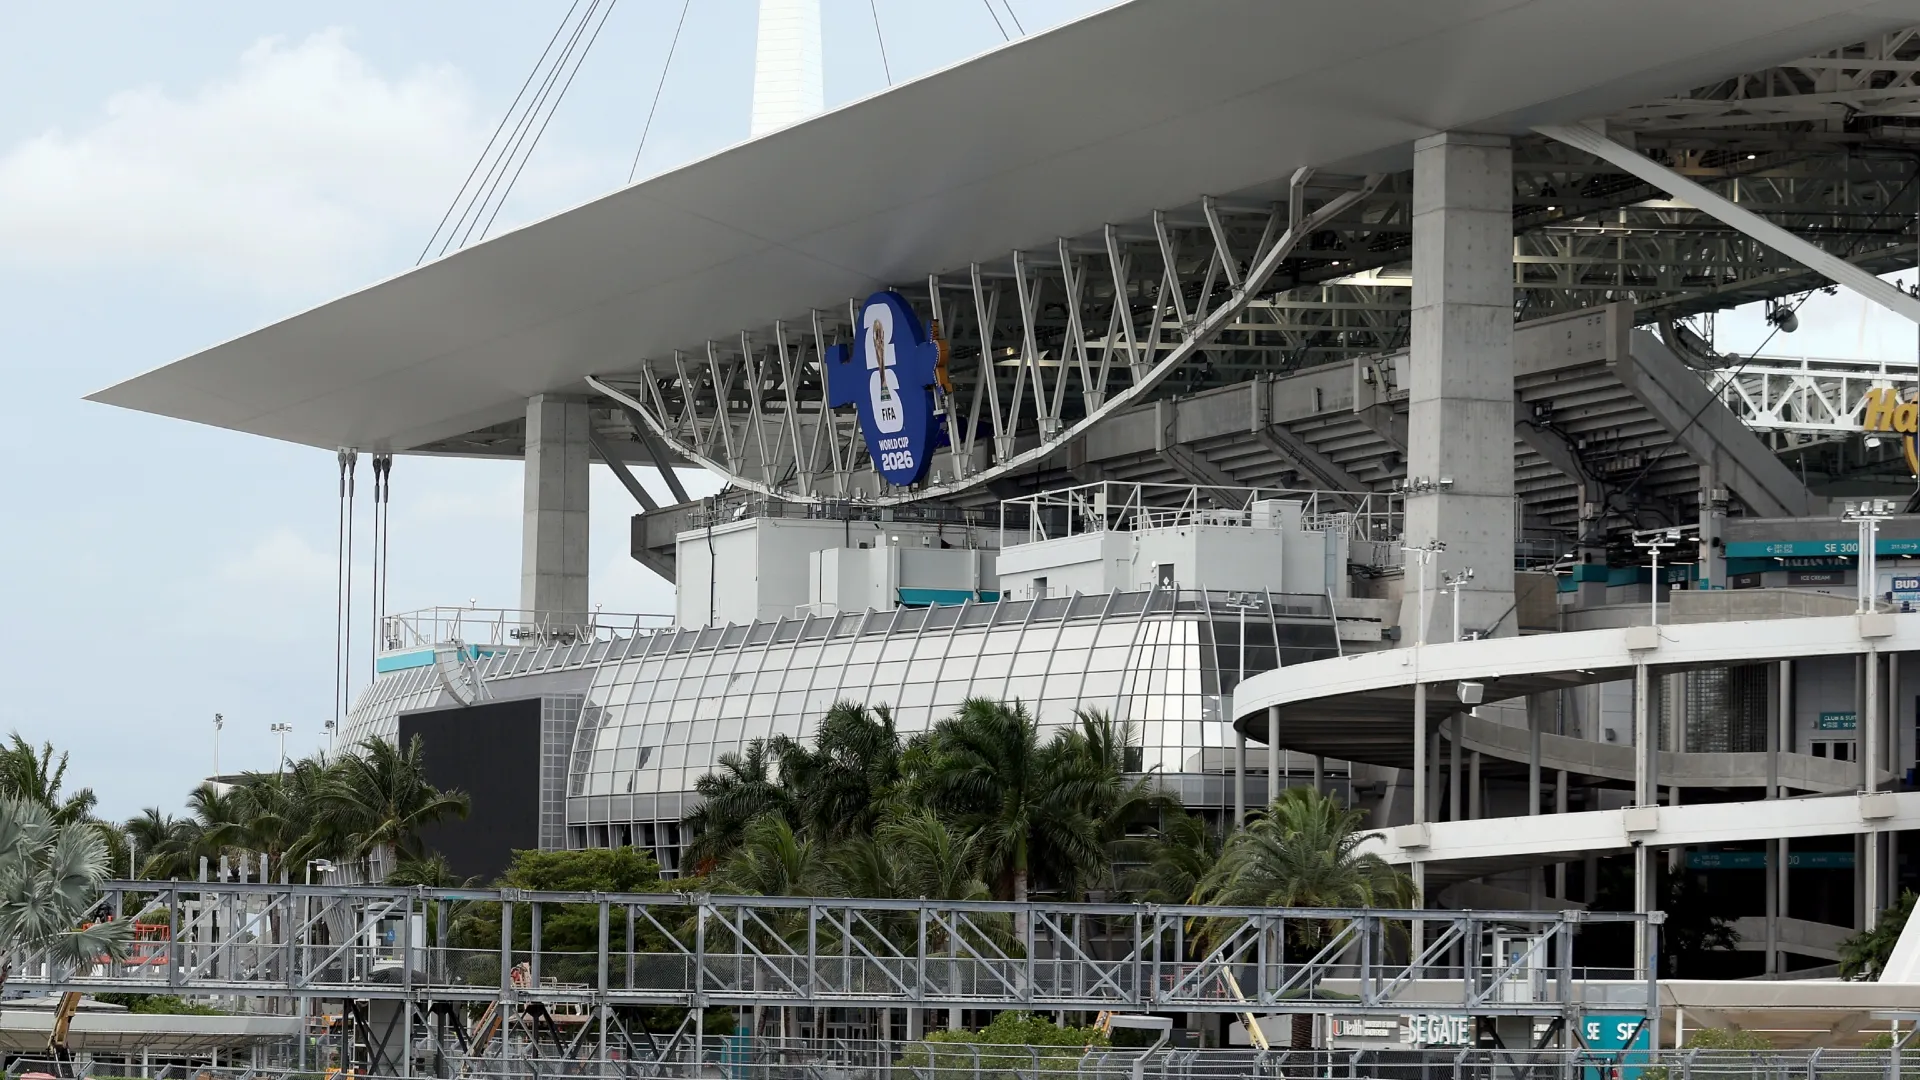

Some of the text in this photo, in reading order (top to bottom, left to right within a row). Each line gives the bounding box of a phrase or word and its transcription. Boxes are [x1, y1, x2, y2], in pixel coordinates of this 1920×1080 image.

[881, 406, 897, 421] FIFA
[879, 436, 909, 451] WORLD CUP
[881, 450, 914, 471] 2026
[1824, 543, 1858, 553] SE 300
[1895, 580, 1918, 589] BUD
[1408, 1014, 1468, 1045] SE GATE
[1587, 1022, 1600, 1040] SE
